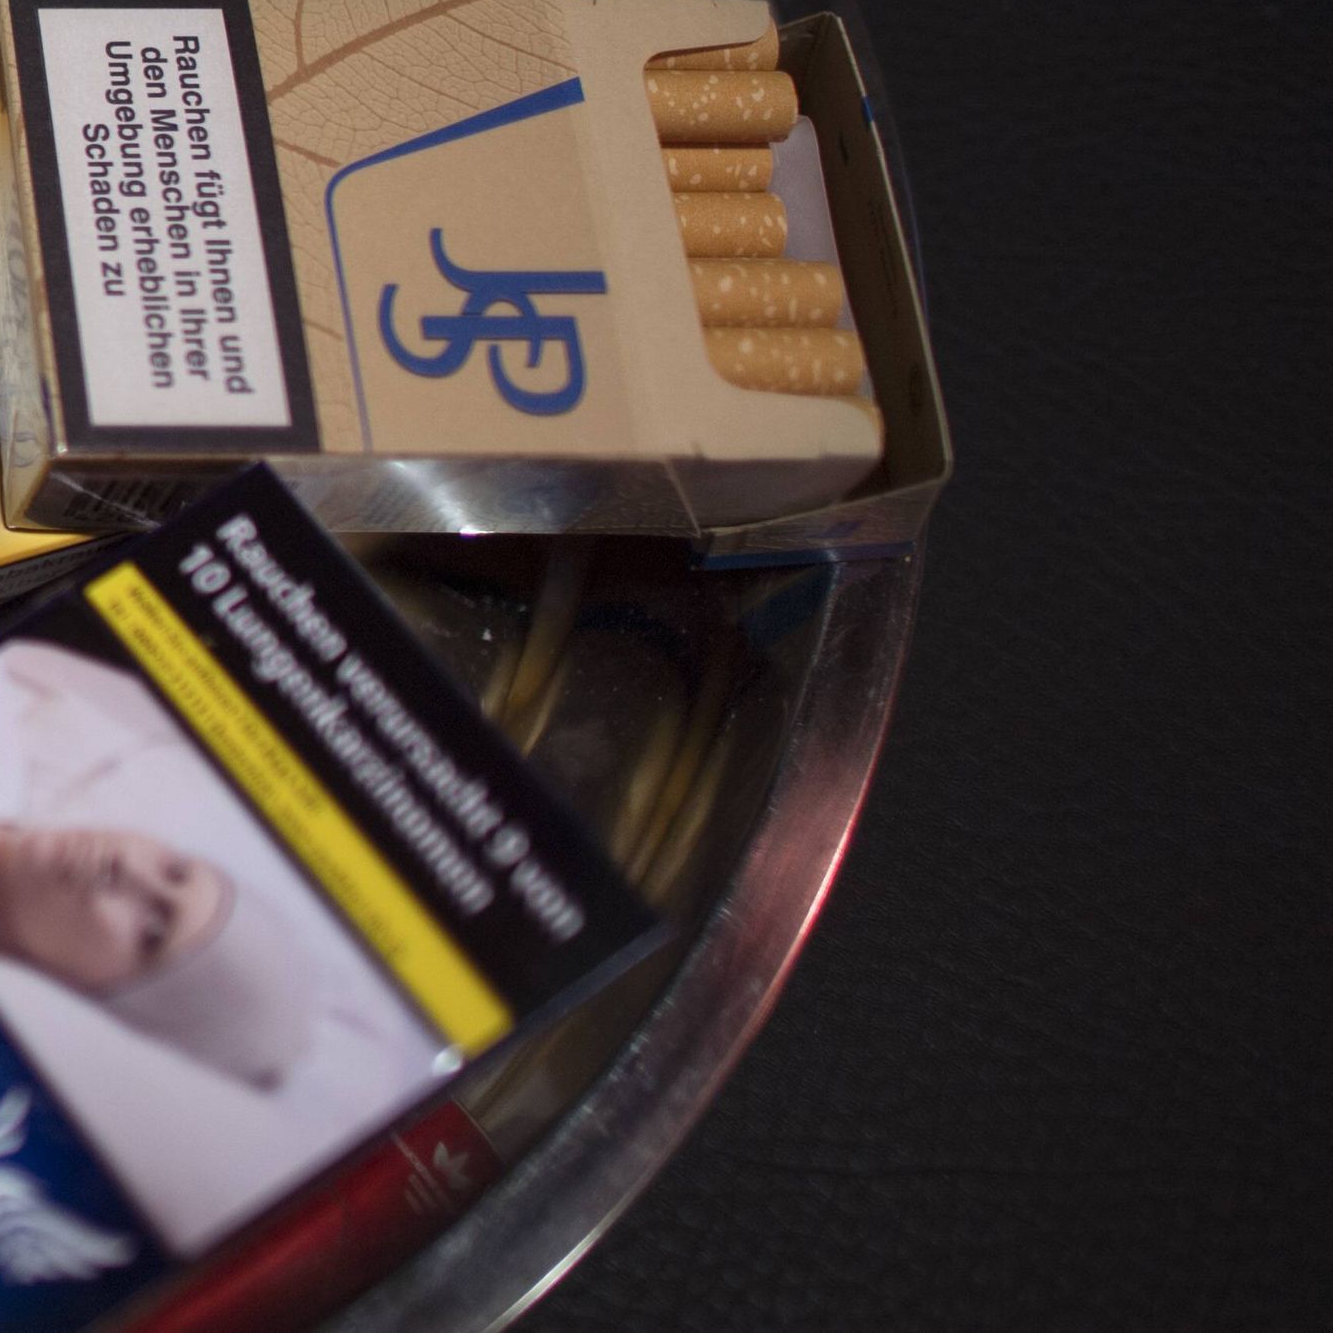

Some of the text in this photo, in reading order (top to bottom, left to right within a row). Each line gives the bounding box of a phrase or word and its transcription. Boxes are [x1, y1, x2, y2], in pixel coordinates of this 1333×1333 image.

[83, 123, 125, 298] Schaden zu
[105, 40, 178, 389] Umgebung erheblichen
[141, 46, 209, 381] den Menschen in Ihrer
[171, 35, 254, 395] Rauchen fügt Ihnen und
[178, 541, 232, 595] 10
[215, 512, 348, 661] Rauchen
[336, 651, 503, 837] verursacht
